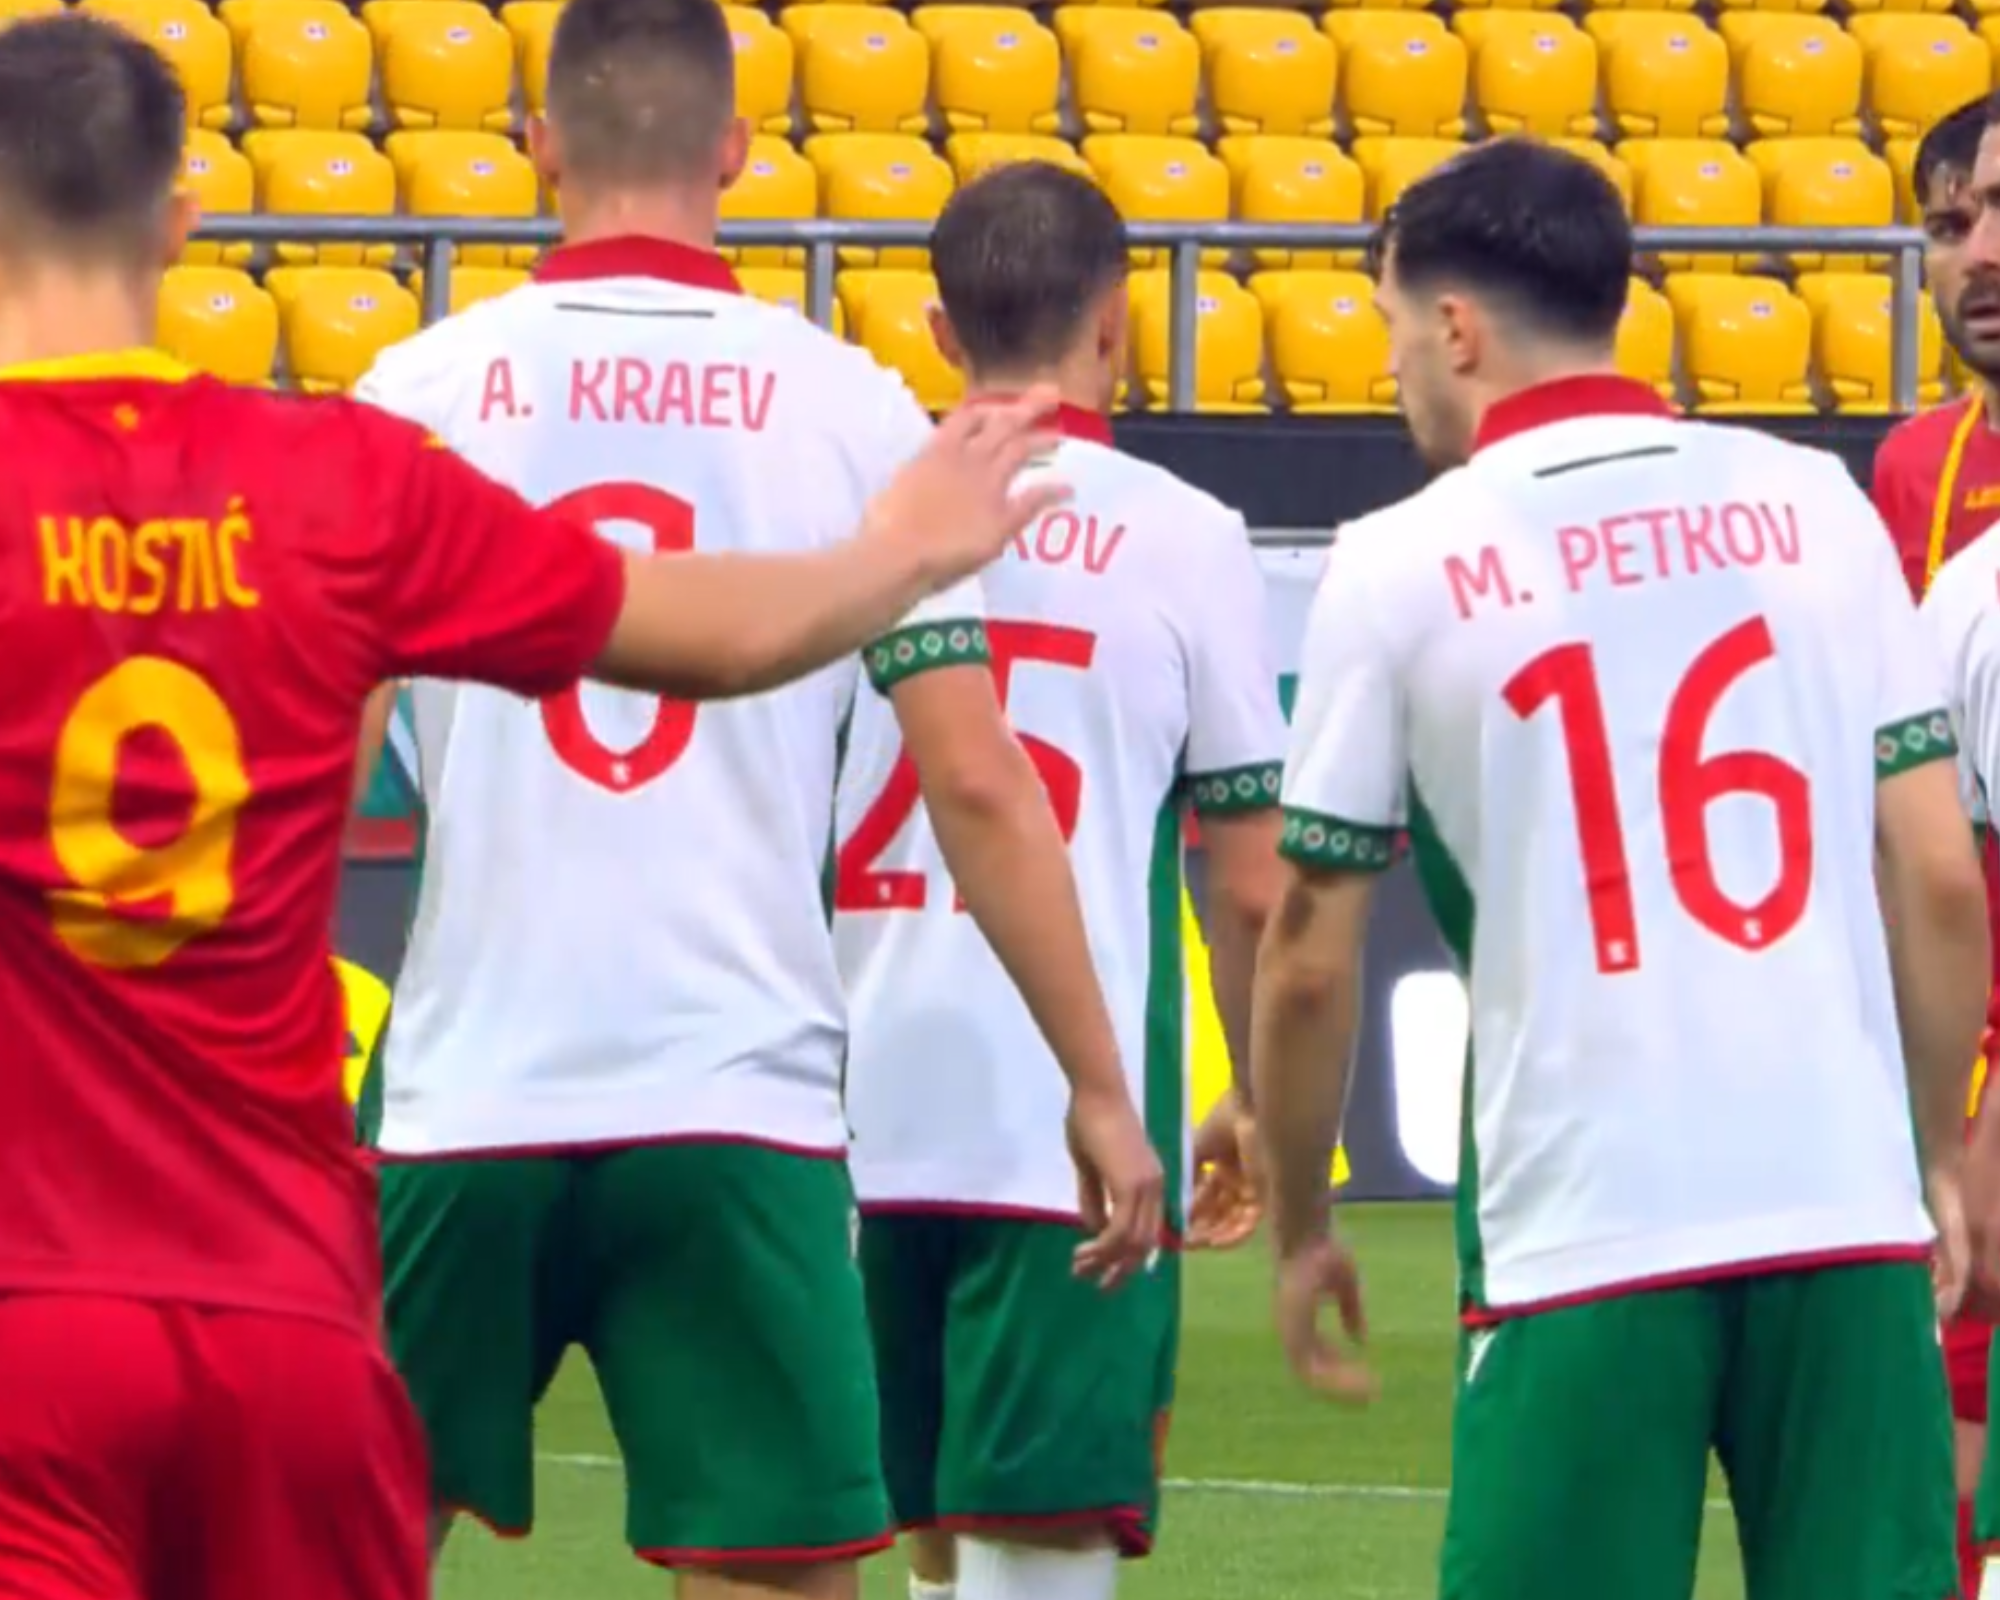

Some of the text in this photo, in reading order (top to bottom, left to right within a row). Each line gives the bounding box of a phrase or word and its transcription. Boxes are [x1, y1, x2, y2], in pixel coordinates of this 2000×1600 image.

[479, 357, 776, 432] A. KRAEV
[39, 496, 261, 614] KOSTIĆ
[1443, 501, 1801, 620] M. PETKOV
[50, 655, 251, 970] 9
[1500, 613, 1813, 975] 16
